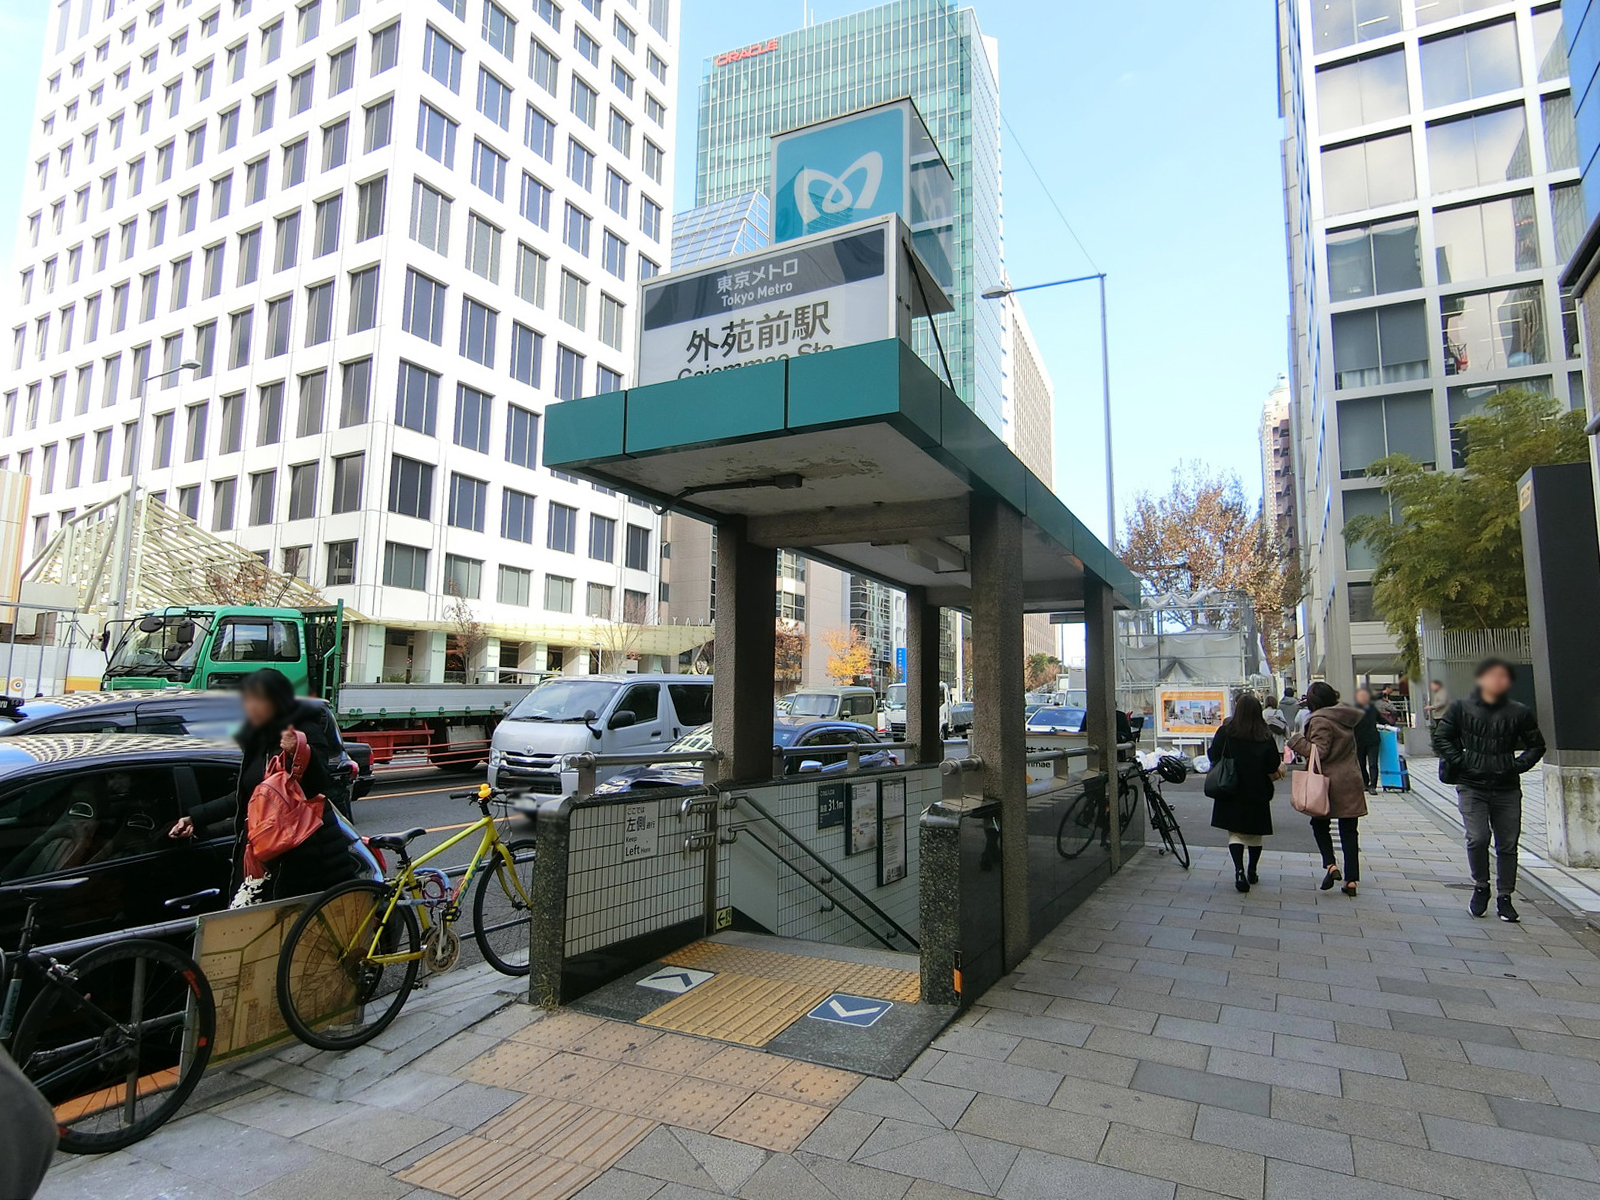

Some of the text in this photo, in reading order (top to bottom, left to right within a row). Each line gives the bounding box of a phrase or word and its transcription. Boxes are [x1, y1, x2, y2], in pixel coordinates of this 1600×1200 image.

[715, 39, 779, 66] ORACLE
[716, 258, 799, 295] 東京メトロ
[721, 281, 793, 307] Tokyo Metro
[686, 300, 831, 364] 外苑前駅
[627, 806, 645, 815] ここでは
[828, 799, 844, 812] 31.1m
[625, 844, 640, 857] Left
